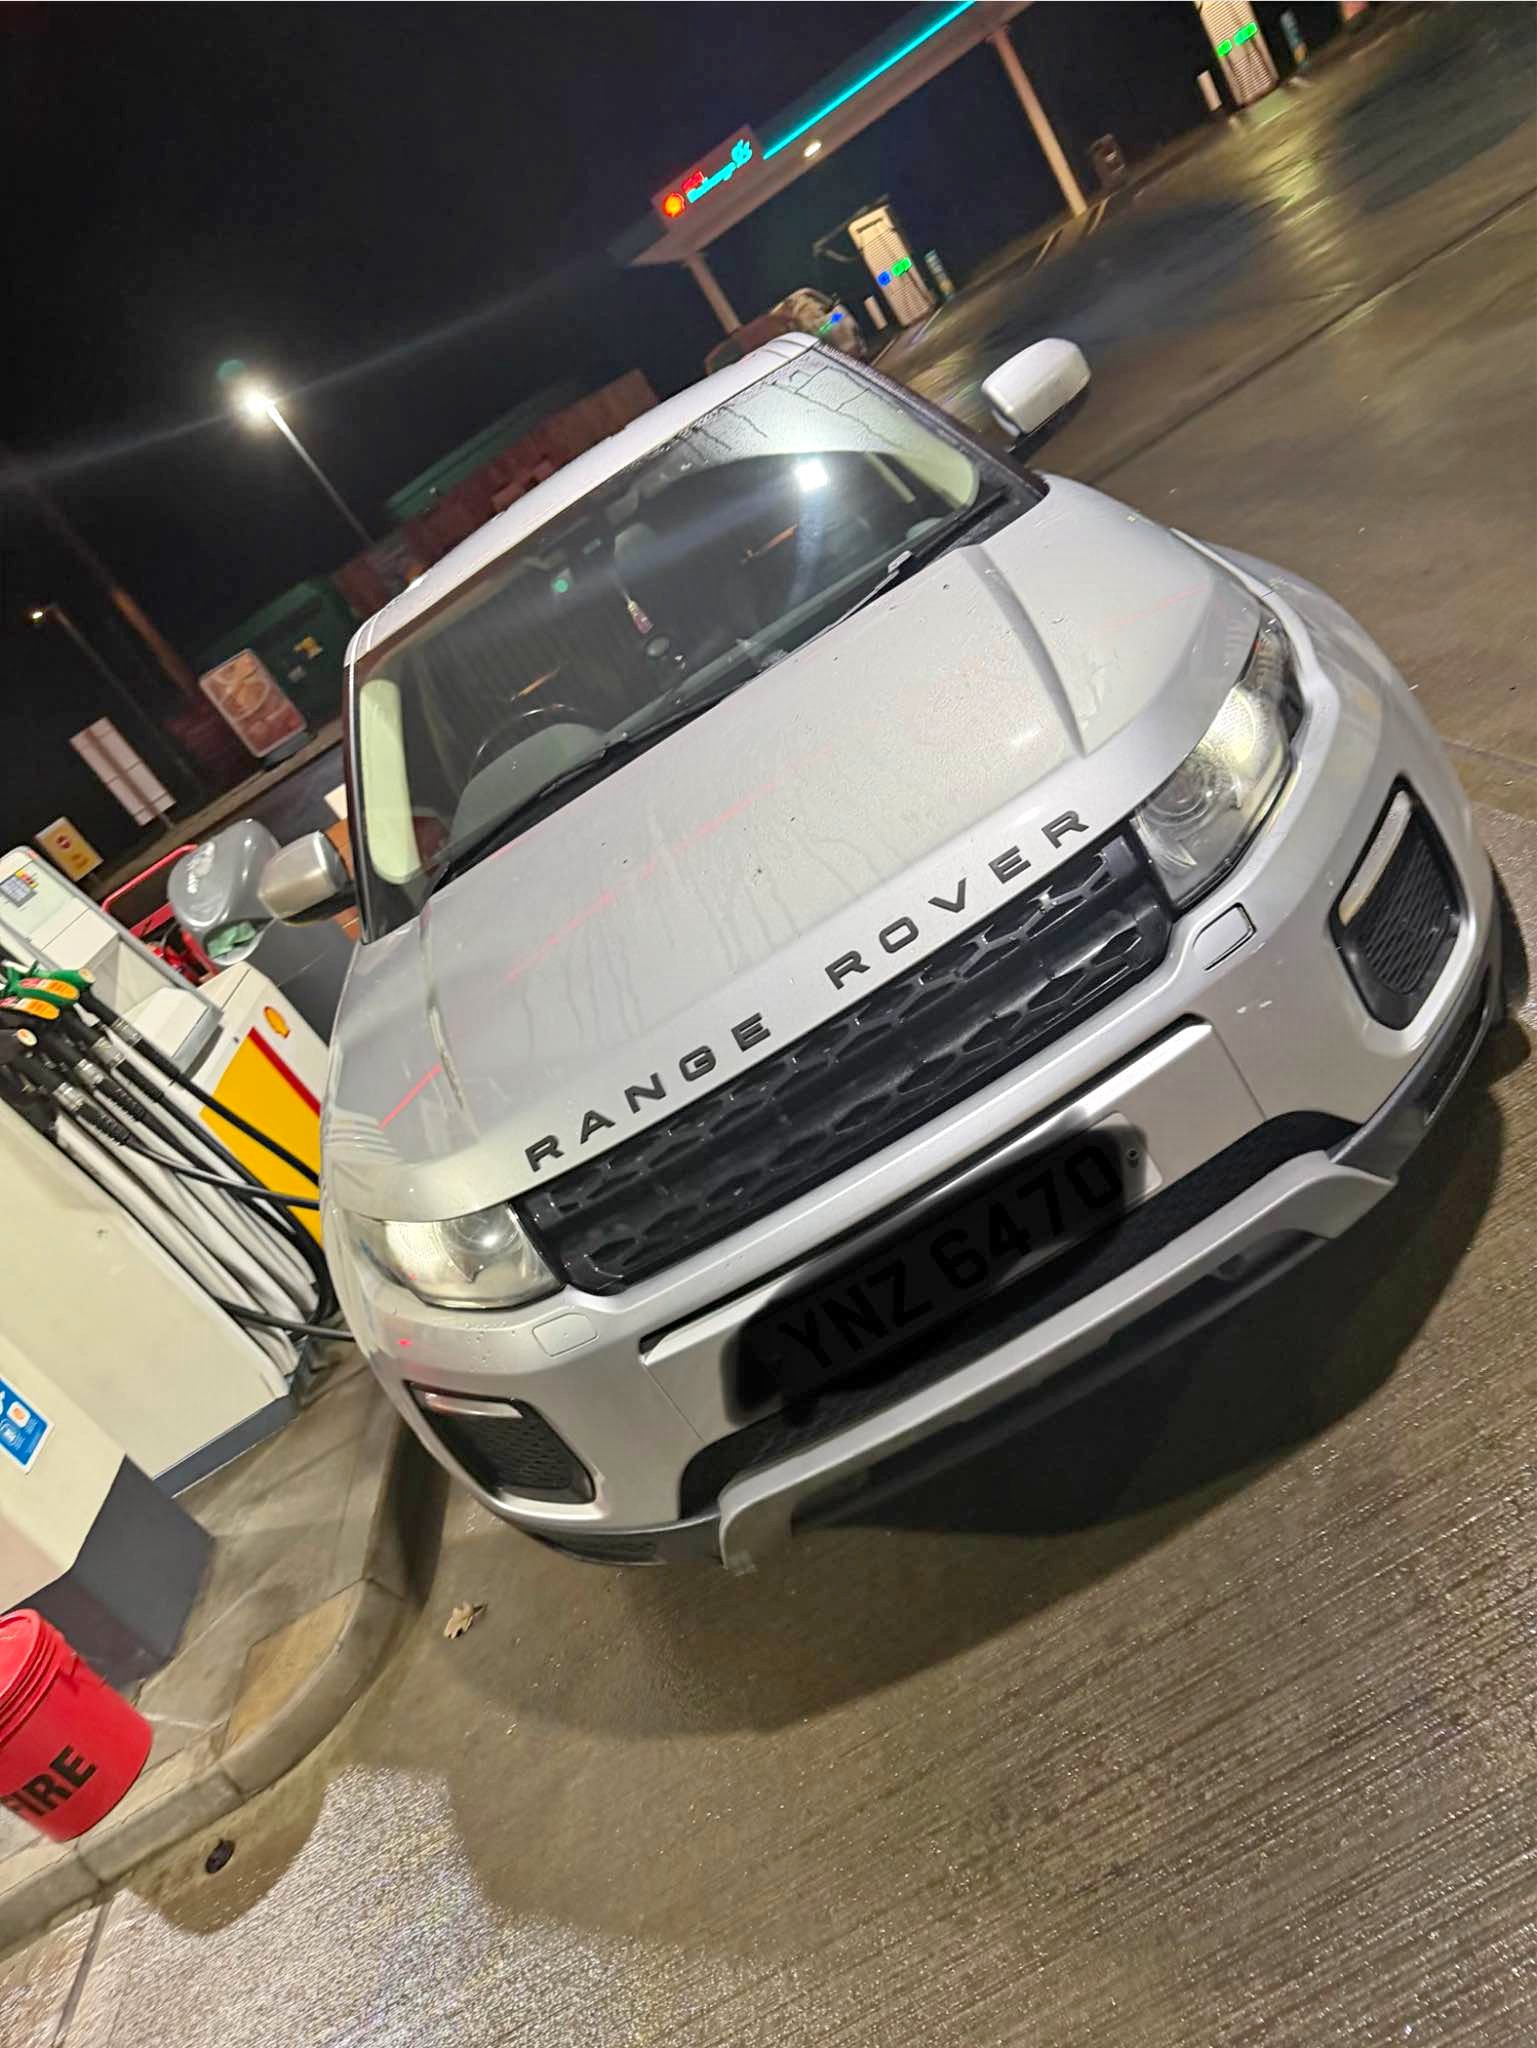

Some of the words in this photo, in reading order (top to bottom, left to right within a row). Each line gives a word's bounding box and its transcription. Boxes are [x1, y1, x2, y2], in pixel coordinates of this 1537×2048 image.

[524, 1012, 771, 1172] RANGE
[825, 810, 1090, 990] ROVER
[778, 1259, 934, 1369] YNZ
[930, 1145, 1124, 1290] 6470
